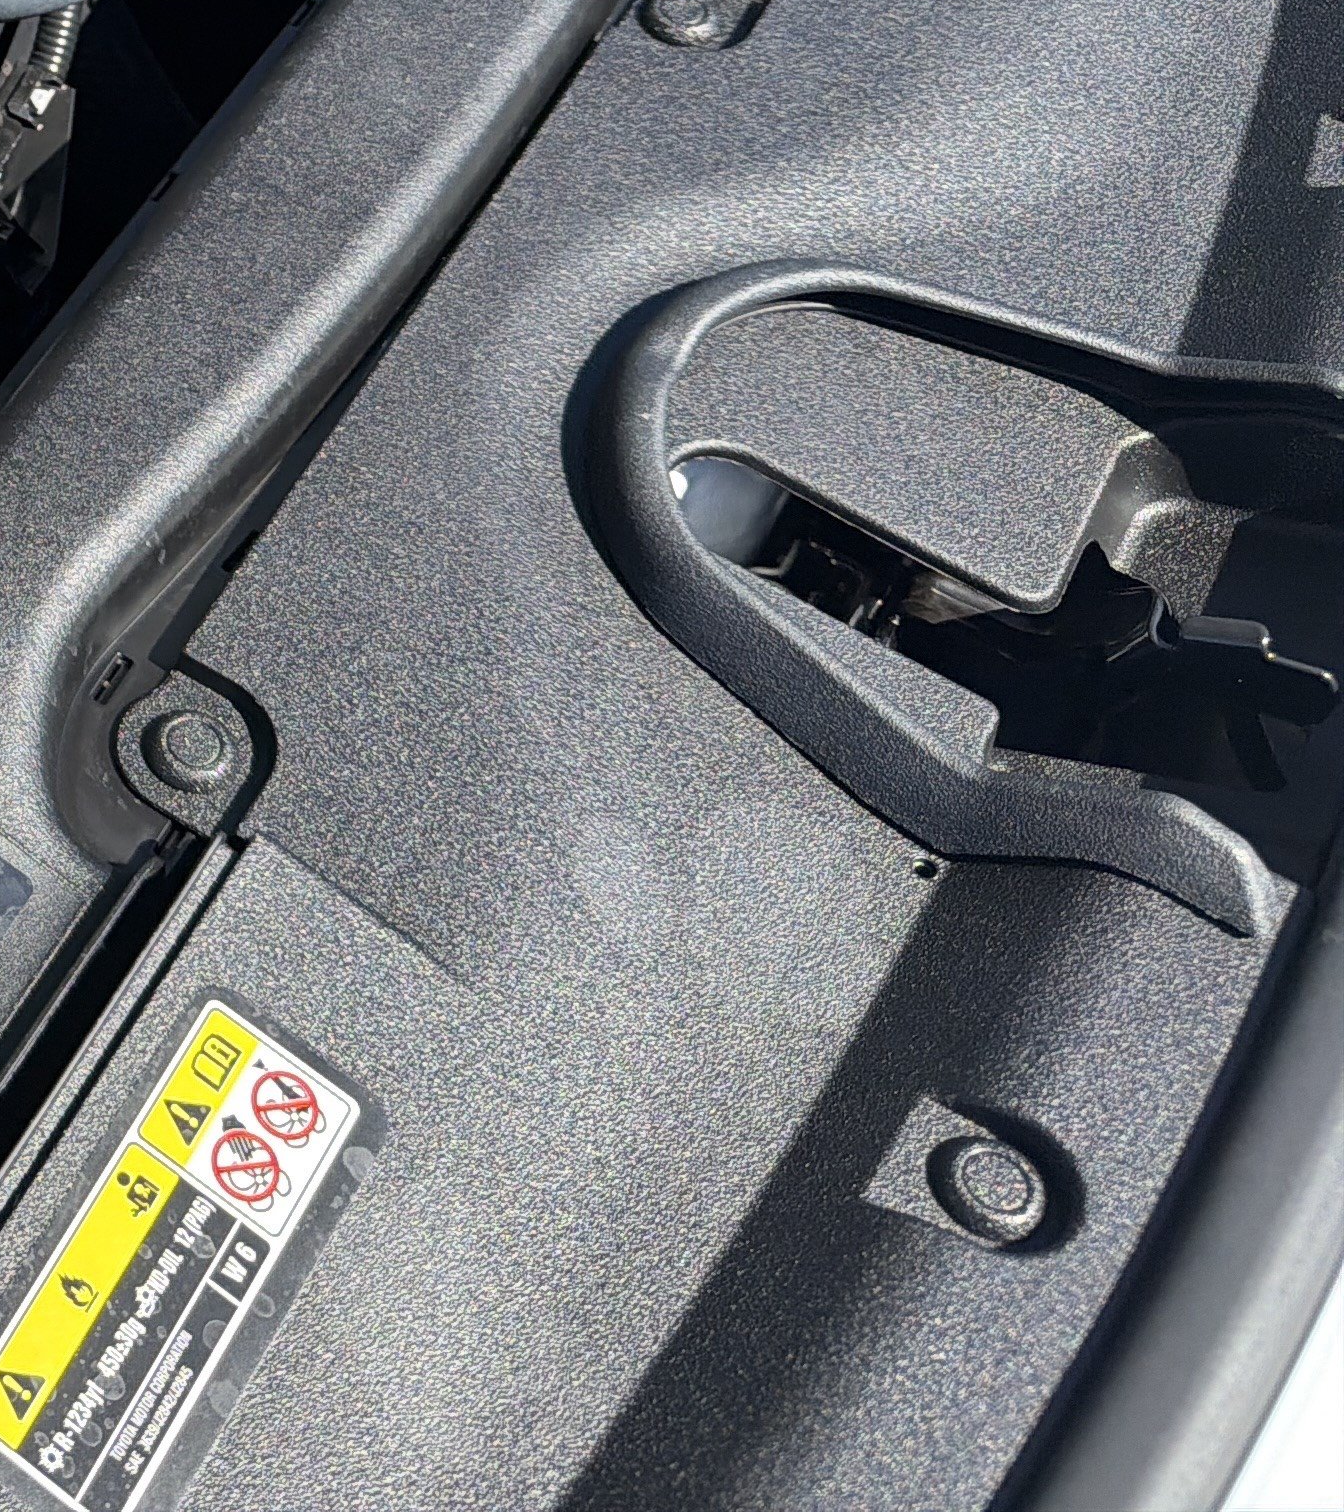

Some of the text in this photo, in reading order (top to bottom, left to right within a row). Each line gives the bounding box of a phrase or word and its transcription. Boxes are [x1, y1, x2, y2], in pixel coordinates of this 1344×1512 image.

[182, 1195, 216, 1235] (PAG)
[173, 1226, 195, 1248] 12
[222, 1241, 258, 1282] W 6
[109, 1329, 192, 1461] TOYOTA MOTOR CORPORATION
[124, 1450, 145, 1475] SAE
